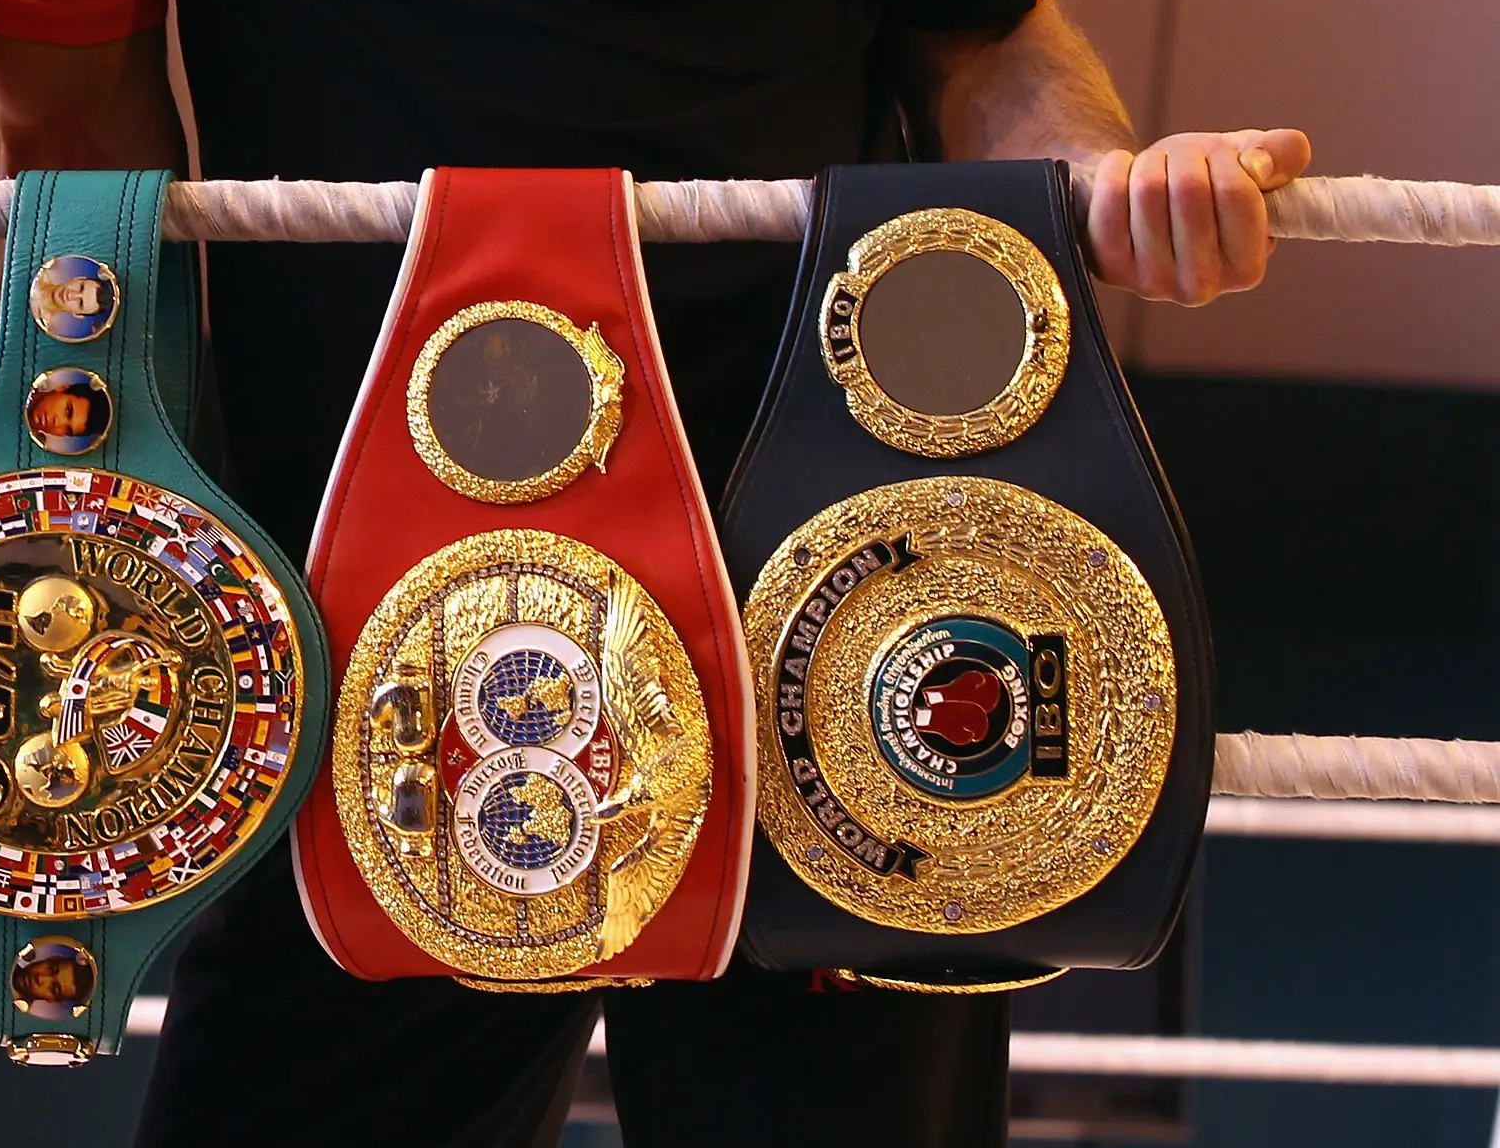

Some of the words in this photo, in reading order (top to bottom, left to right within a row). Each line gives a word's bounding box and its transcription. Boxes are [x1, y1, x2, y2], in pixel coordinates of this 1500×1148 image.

[68, 537, 210, 648] WORLD
[781, 548, 881, 736] CHAMPION
[457, 651, 490, 748] Champion
[571, 659, 595, 739] World
[893, 643, 956, 774] CHAMPIONSHIP
[1001, 664, 1028, 749] BOXING
[1033, 649, 1062, 759] IBO
[63, 666, 228, 849] CHAMPION
[463, 753, 527, 799] Boxing
[589, 739, 613, 787] IBF
[455, 811, 527, 890] Federation
[793, 757, 888, 869] WORLD
